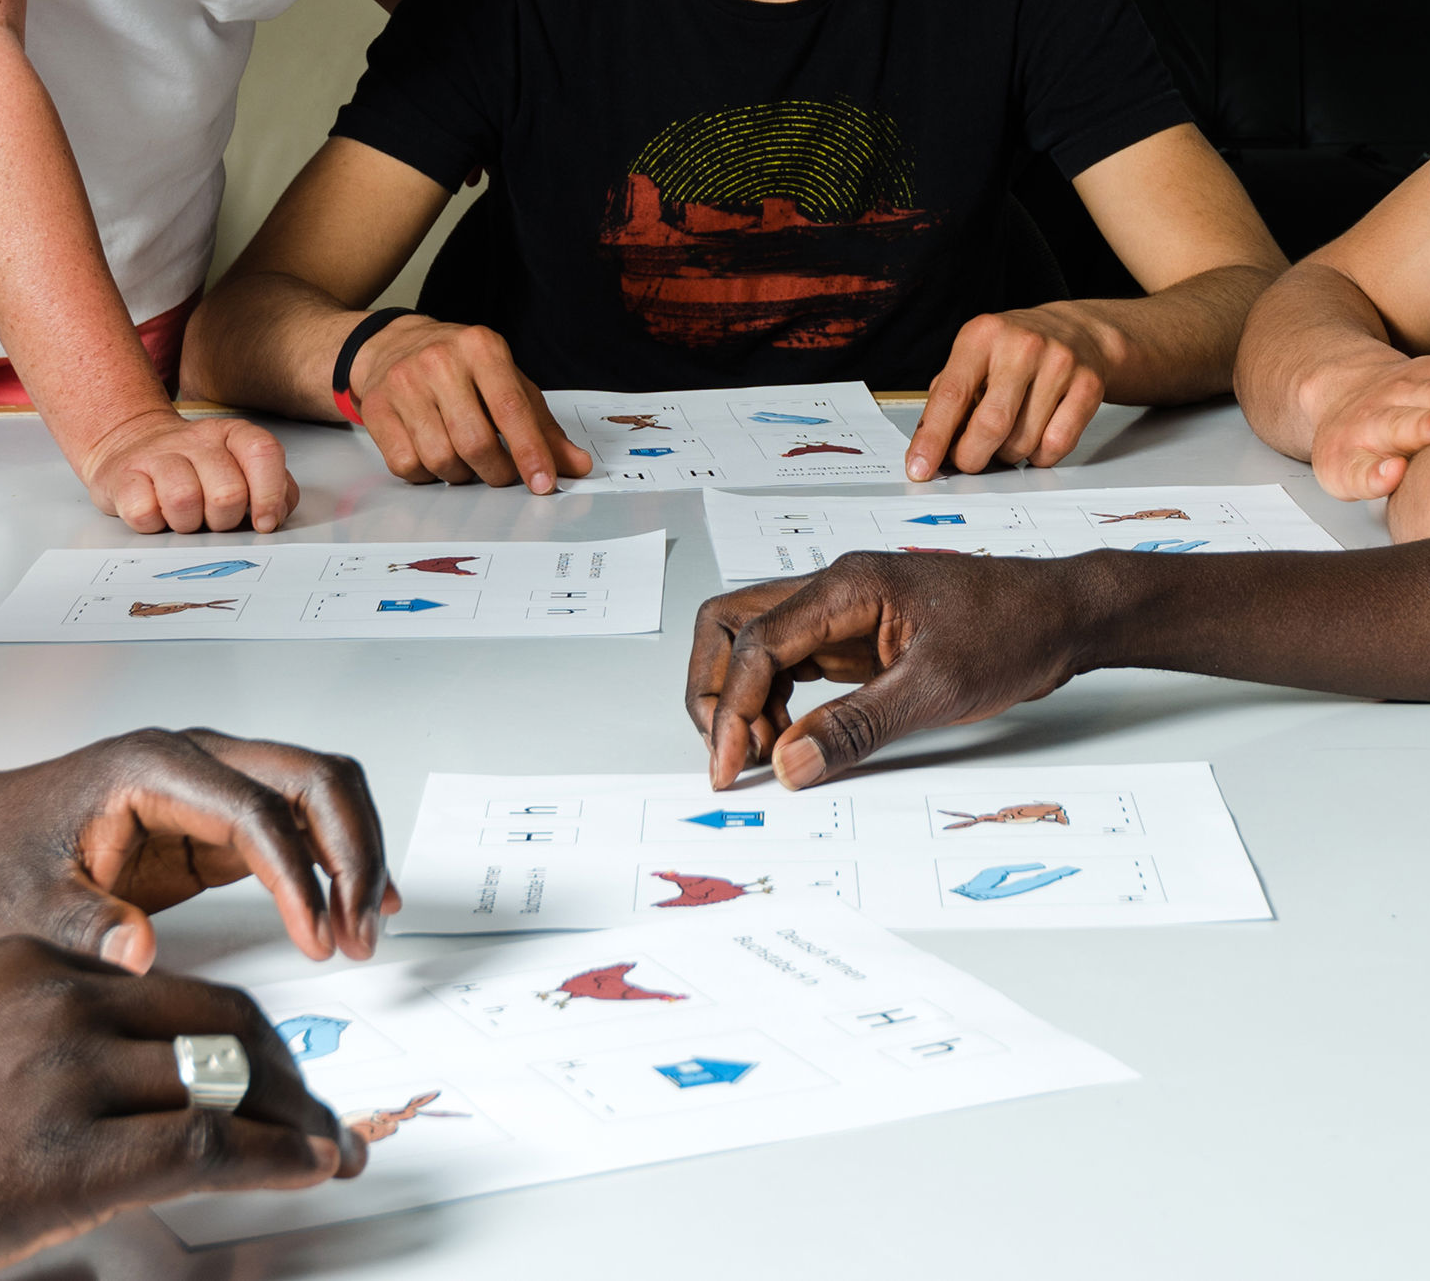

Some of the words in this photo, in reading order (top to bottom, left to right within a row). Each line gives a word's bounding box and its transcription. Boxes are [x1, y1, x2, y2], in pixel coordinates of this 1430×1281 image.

[507, 831, 554, 842] H
[776, 928, 830, 956] Deutsch
[817, 955, 867, 981] lernen
[855, 1007, 918, 1028] H
[911, 1037, 962, 1057] h
